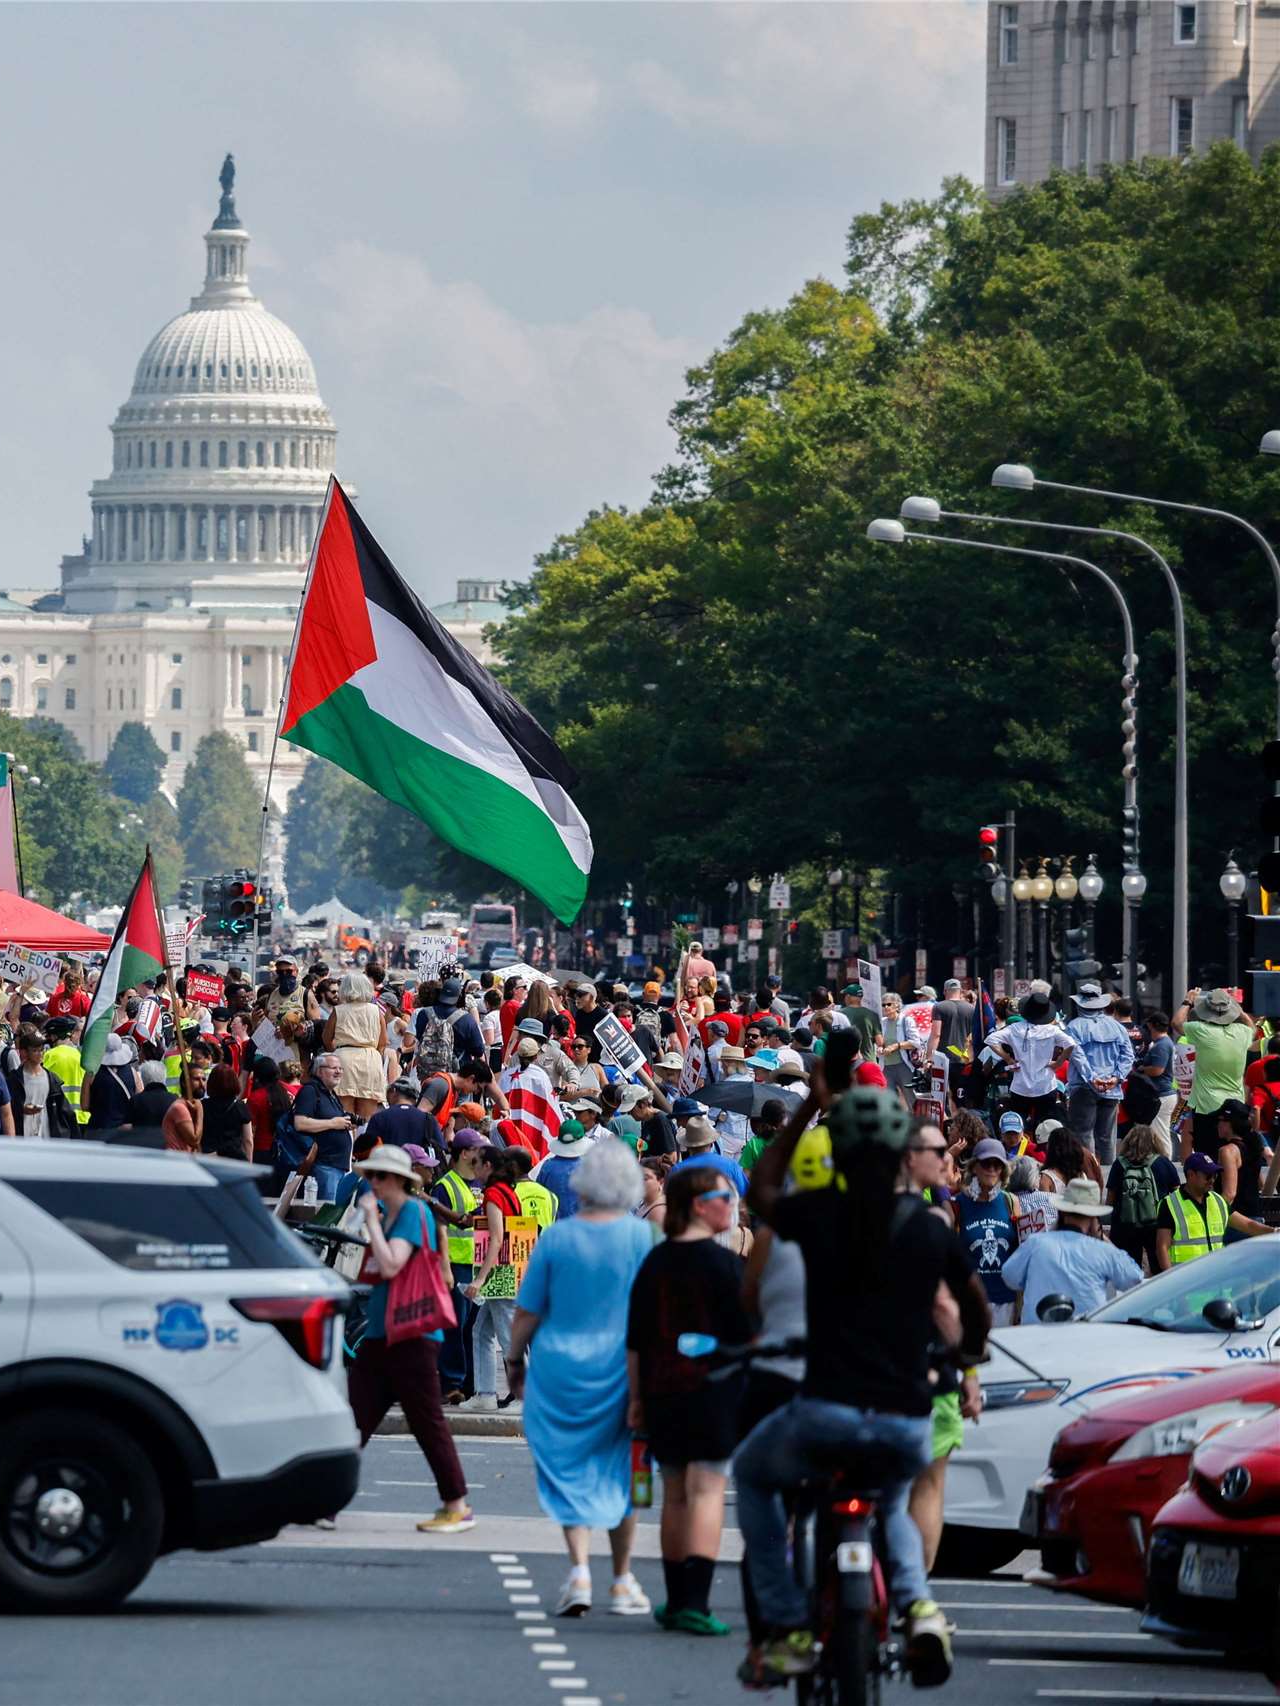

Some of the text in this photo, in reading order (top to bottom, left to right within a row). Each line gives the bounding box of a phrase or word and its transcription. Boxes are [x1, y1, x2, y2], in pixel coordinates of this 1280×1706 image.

[7, 943, 61, 973] FREEDOM
[3, 960, 26, 977] FOR
[214, 1328, 239, 1342] DC
